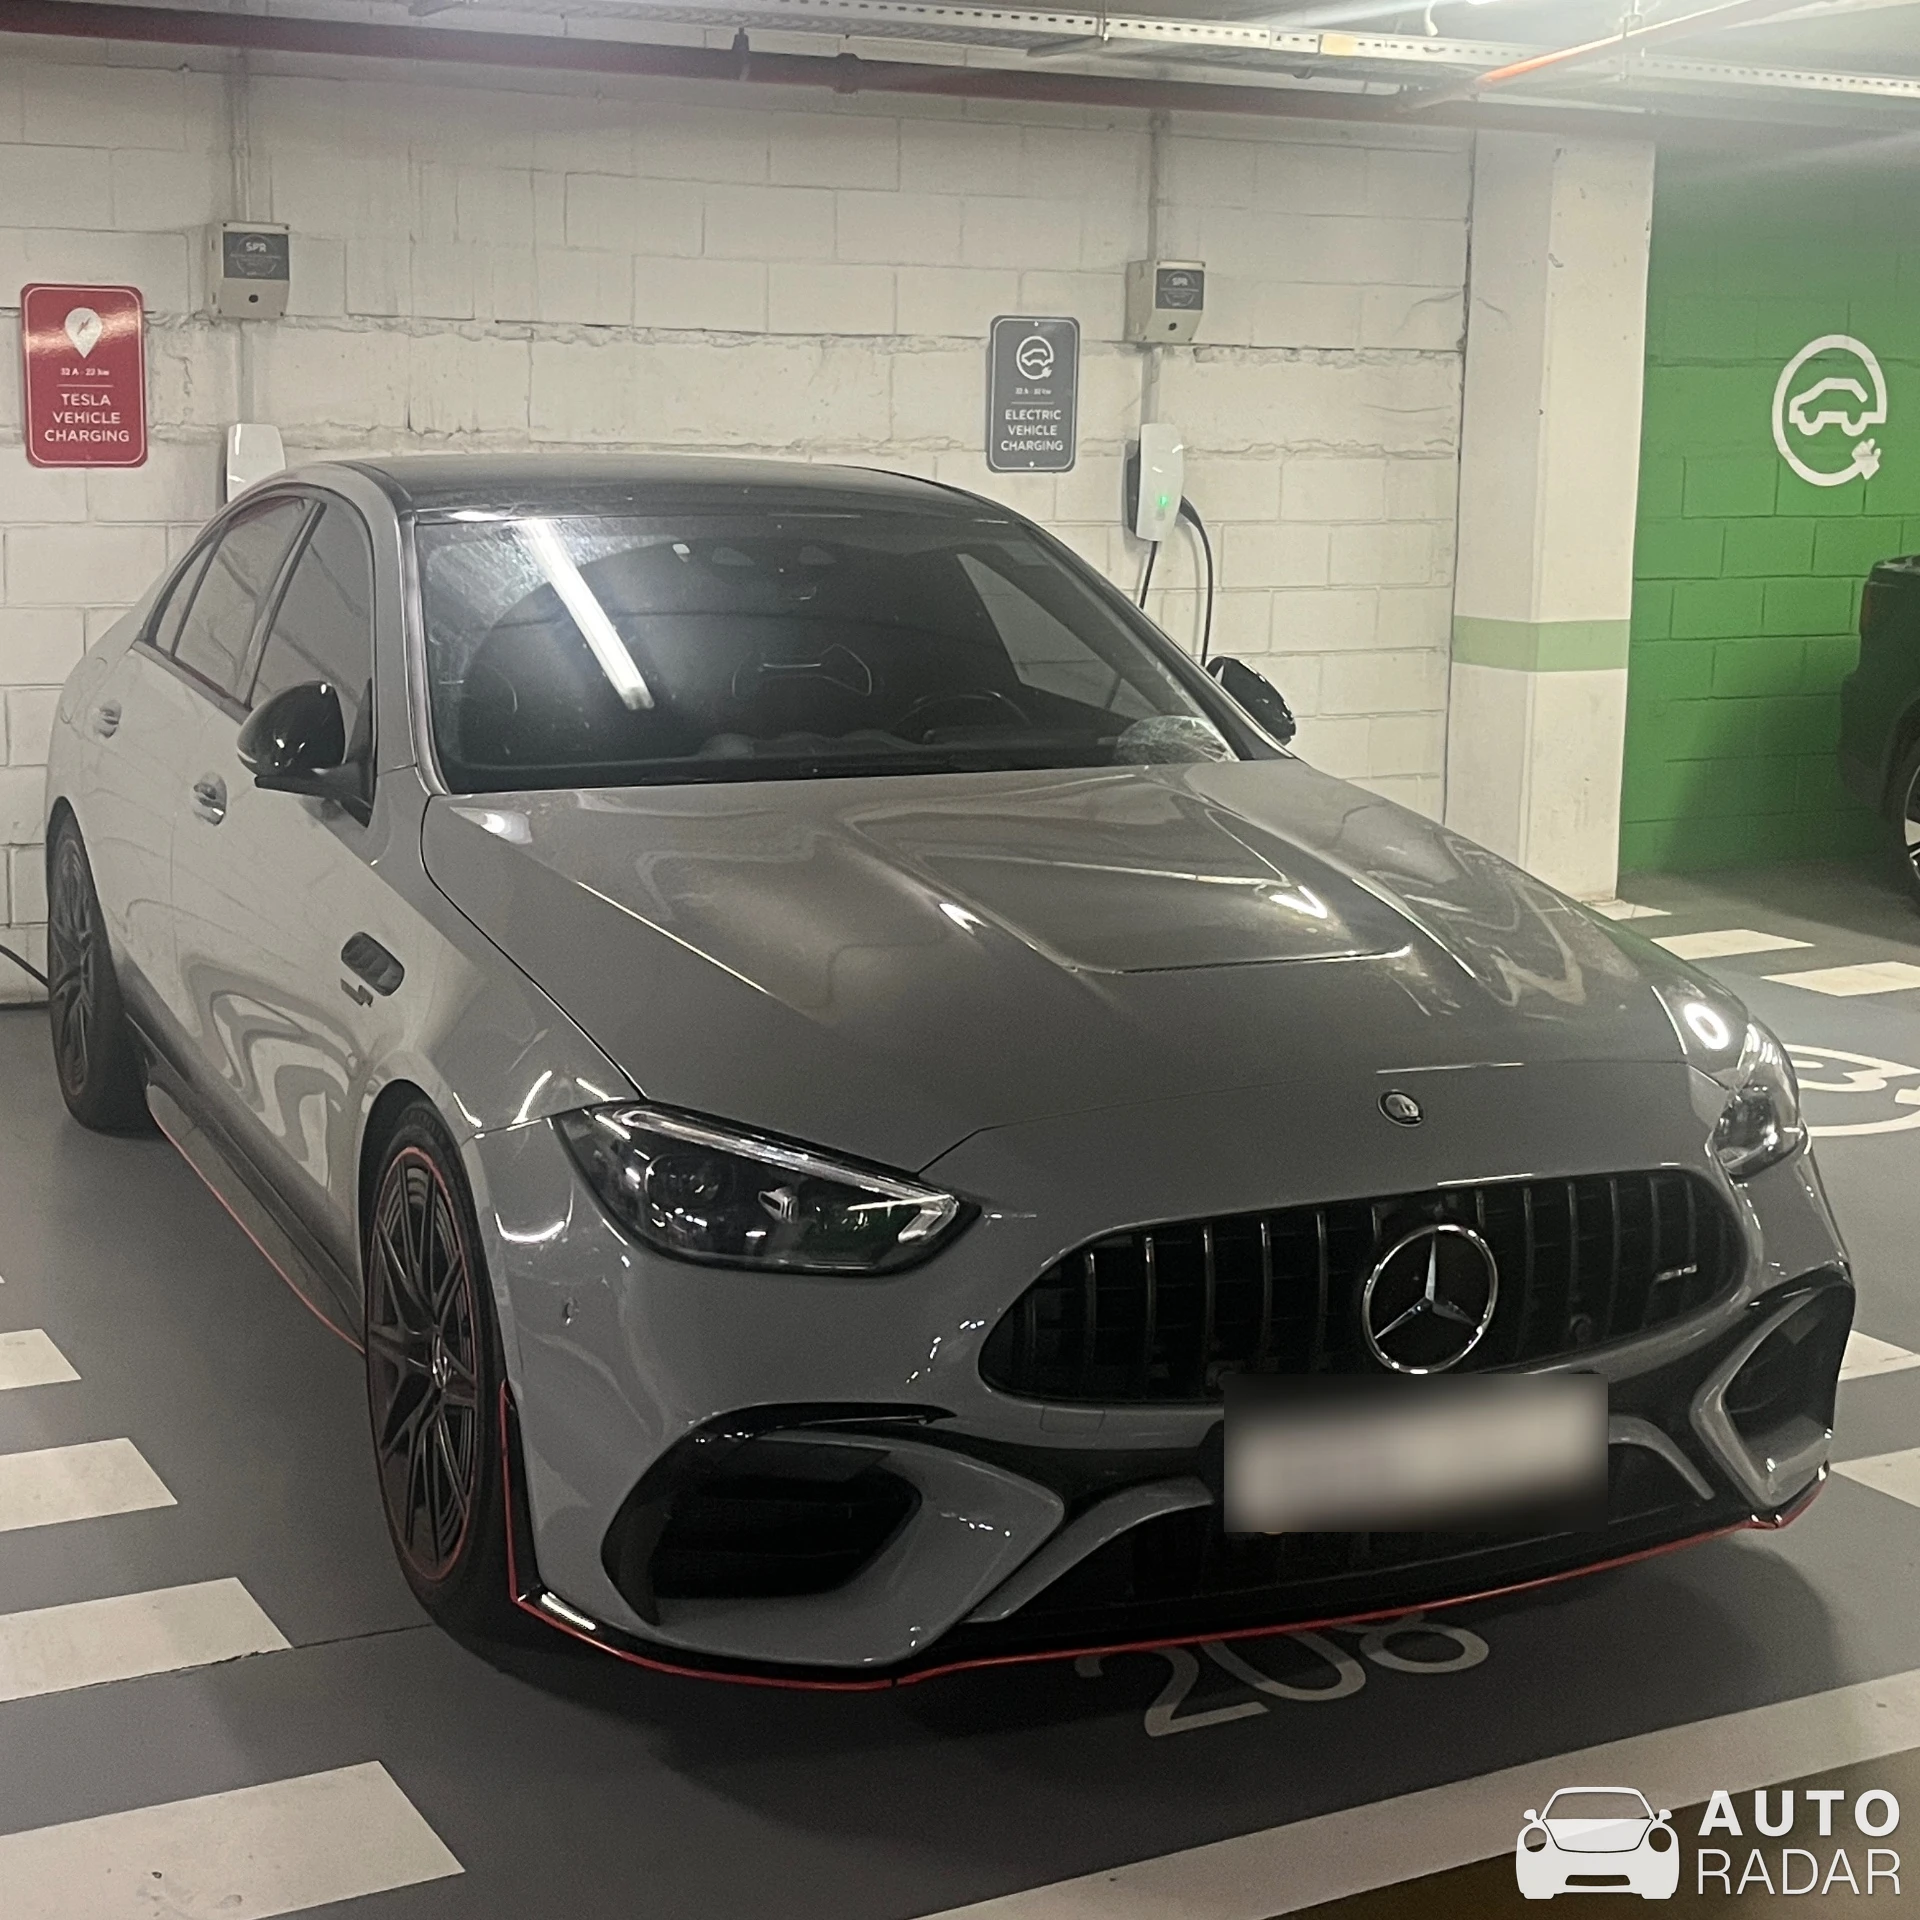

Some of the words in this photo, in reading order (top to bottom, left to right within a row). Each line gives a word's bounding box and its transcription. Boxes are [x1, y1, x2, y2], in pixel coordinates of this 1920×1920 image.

[245, 241, 267, 253] SPR
[61, 393, 111, 407] TESLA
[52, 410, 121, 424] VEHICLE
[1005, 408, 1062, 421] ELECTRIC
[44, 429, 130, 443] CHARGING
[1007, 424, 1058, 437] VEHICLE
[1000, 440, 1064, 452] CHARGING
